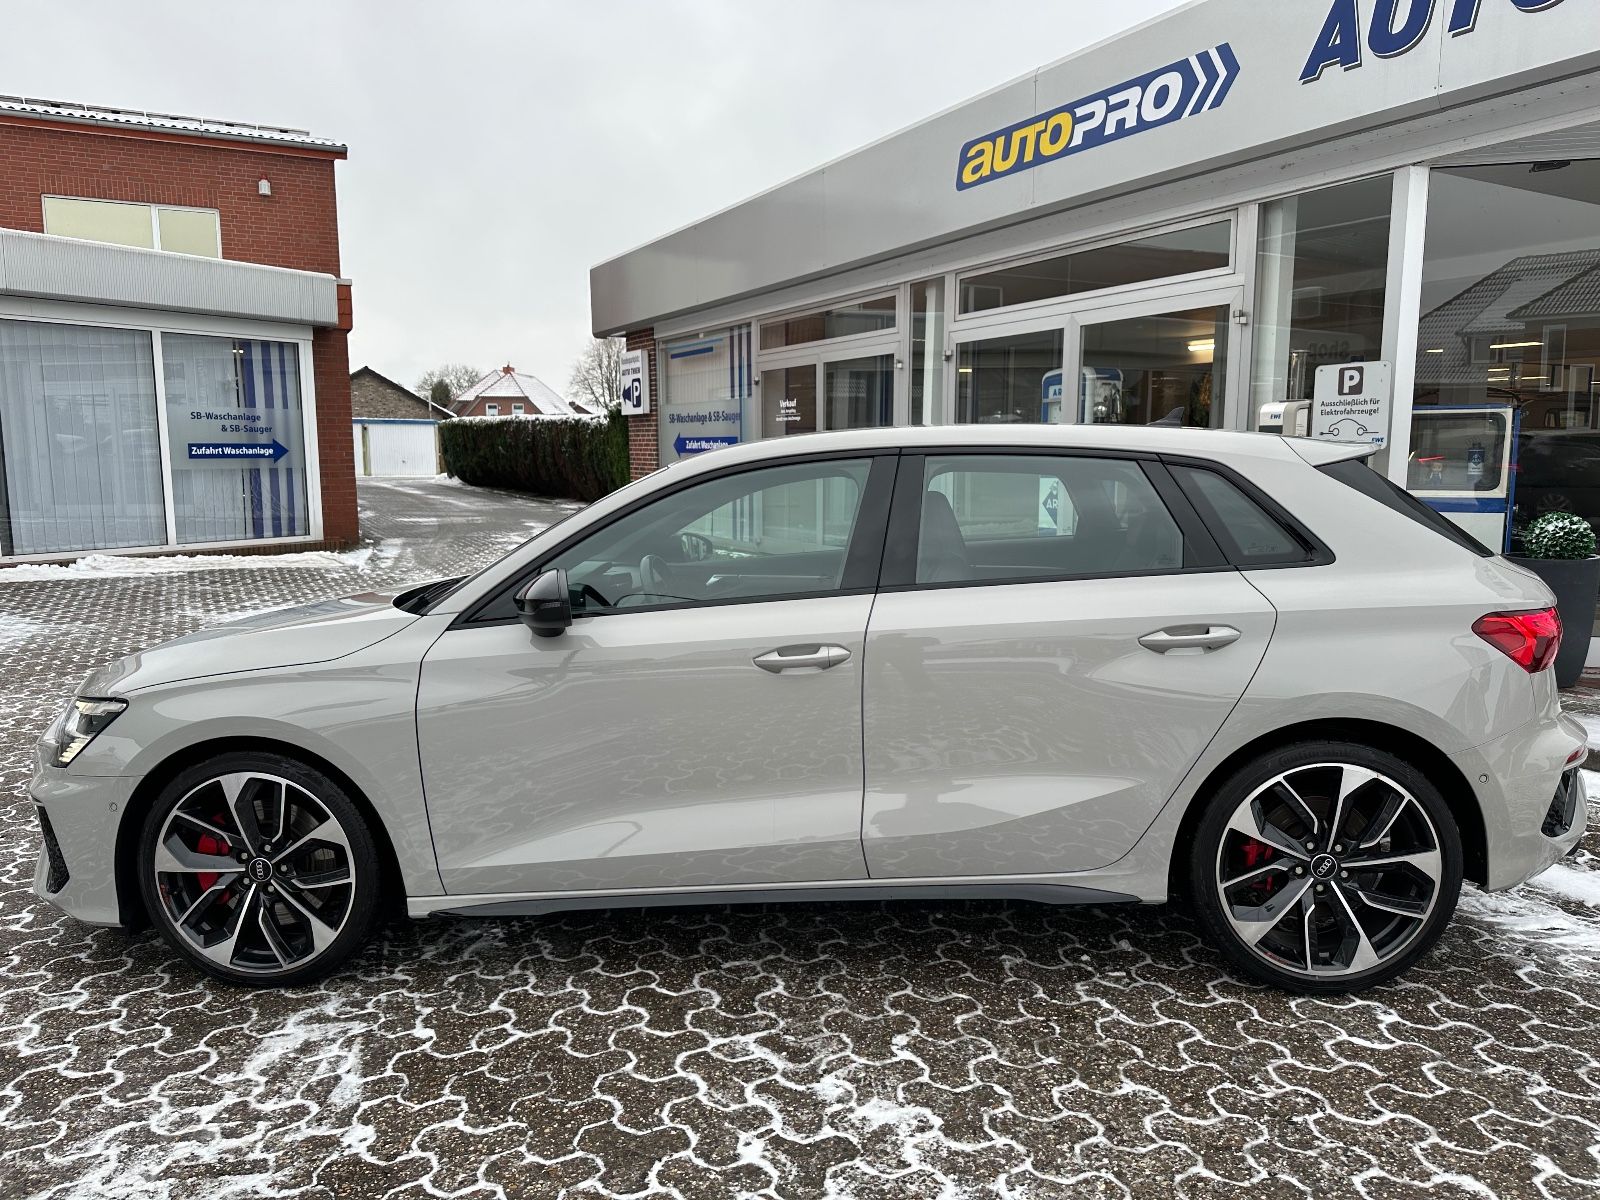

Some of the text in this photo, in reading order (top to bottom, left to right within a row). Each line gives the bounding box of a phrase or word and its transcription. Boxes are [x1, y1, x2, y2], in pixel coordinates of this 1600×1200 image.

[1298, 0, 1566, 84] AU
[1343, 369, 1361, 393] P
[1053, 388, 1062, 396] AR
[1321, 397, 1380, 407] Ausschließlich für
[1321, 406, 1379, 416] Elektrofahrzeuge!
[190, 411, 261, 422] SB-Waschanlage
[668, 412, 707, 425] SB-Waschanlage
[708, 411, 713, 422] &
[221, 424, 273, 434] & SB-Sauger
[685, 440, 700, 449] Zufahrt
[191, 446, 274, 457] Zufahrt Waschanlage
